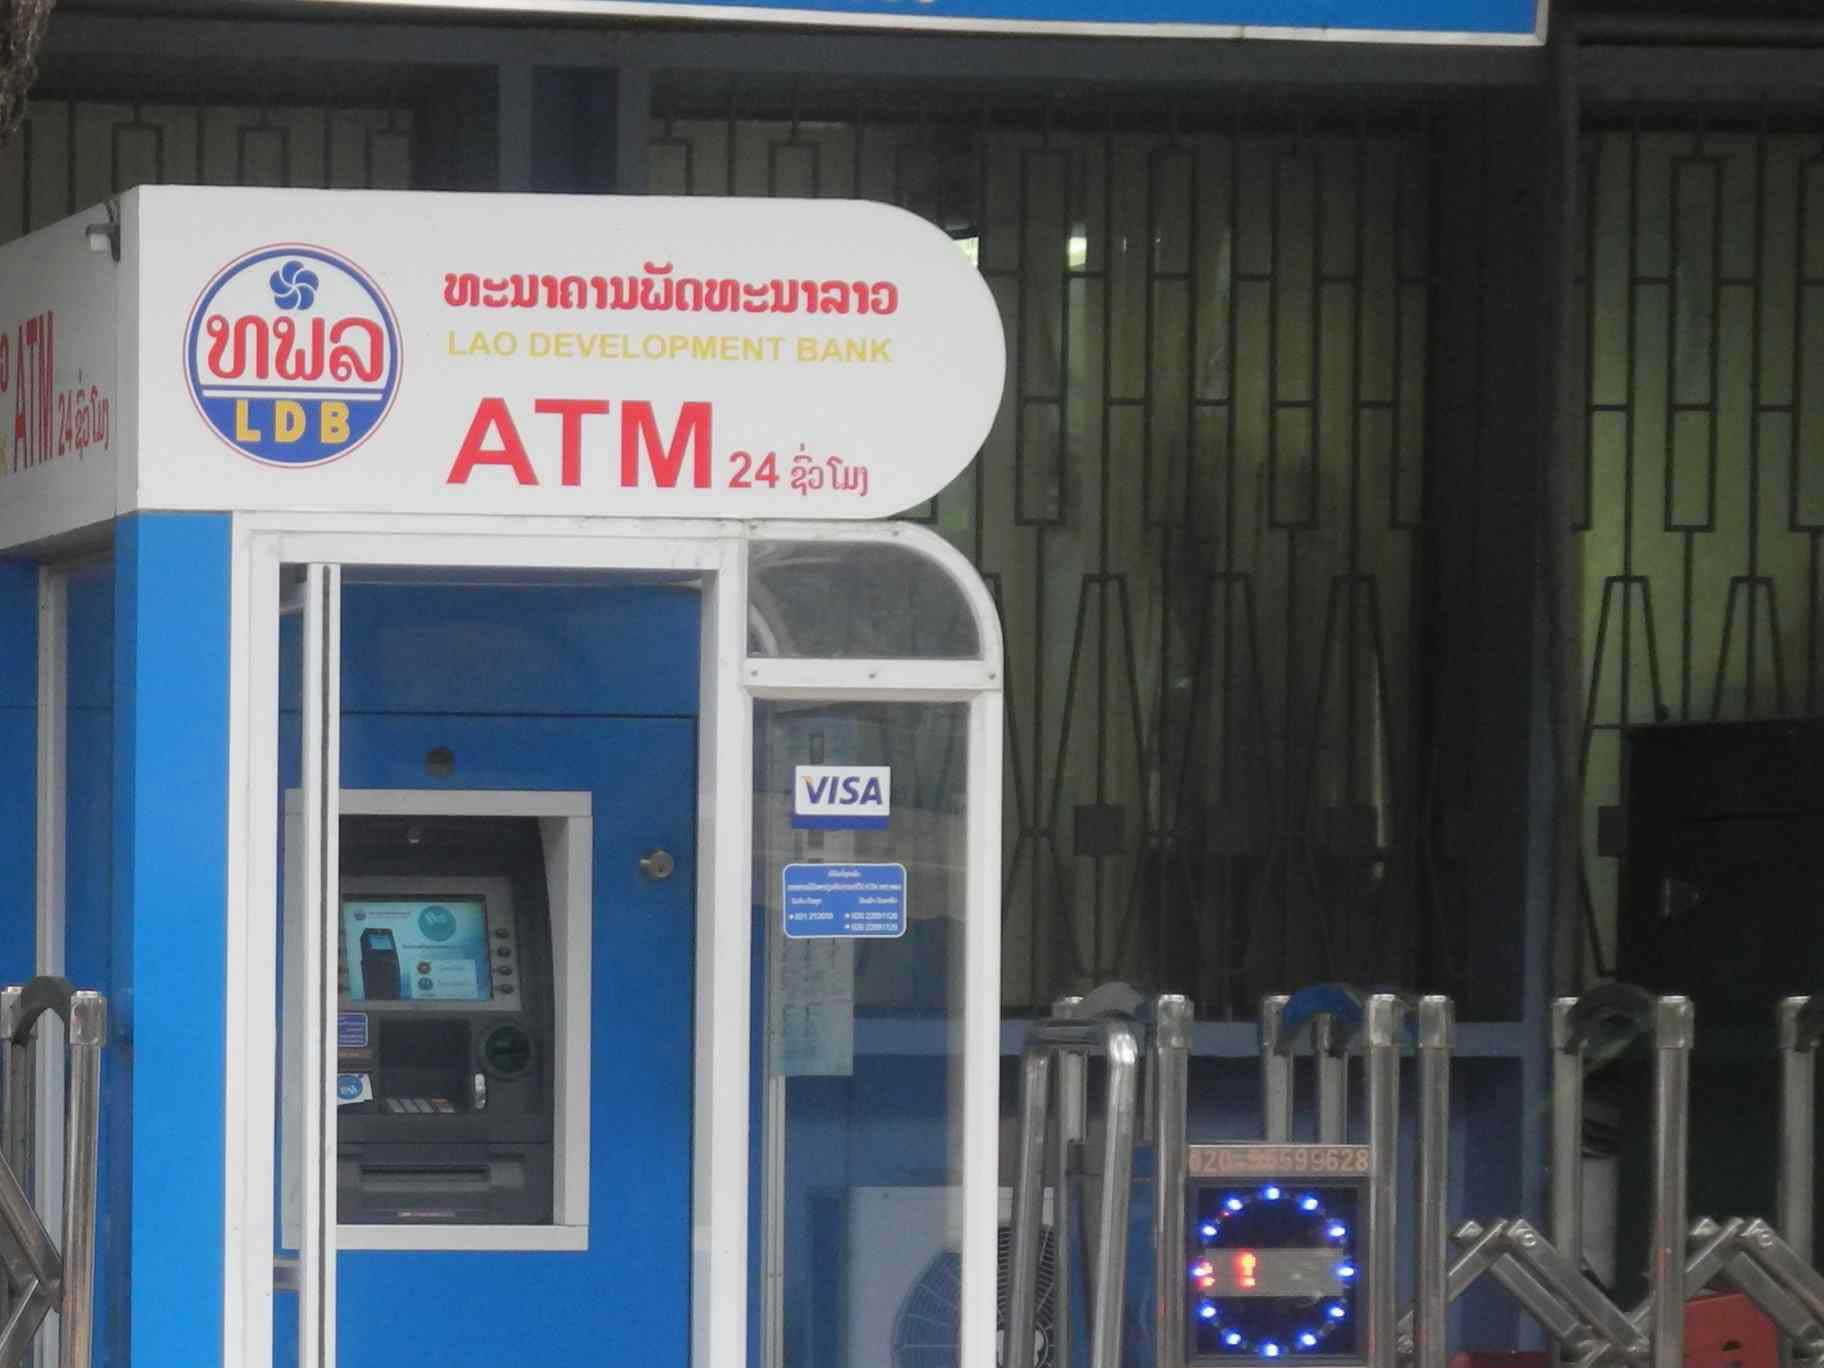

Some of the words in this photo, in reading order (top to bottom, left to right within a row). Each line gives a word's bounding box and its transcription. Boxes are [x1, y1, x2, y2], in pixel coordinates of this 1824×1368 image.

[447, 330, 518, 359] LAO
[529, 332, 785, 362] DEVELOPMENT
[796, 337, 893, 364] BANK
[14, 310, 54, 473] ATM
[236, 399, 351, 444] LDB
[446, 396, 713, 489] ATM
[727, 450, 780, 489] 24
[801, 775, 883, 805] VISA
